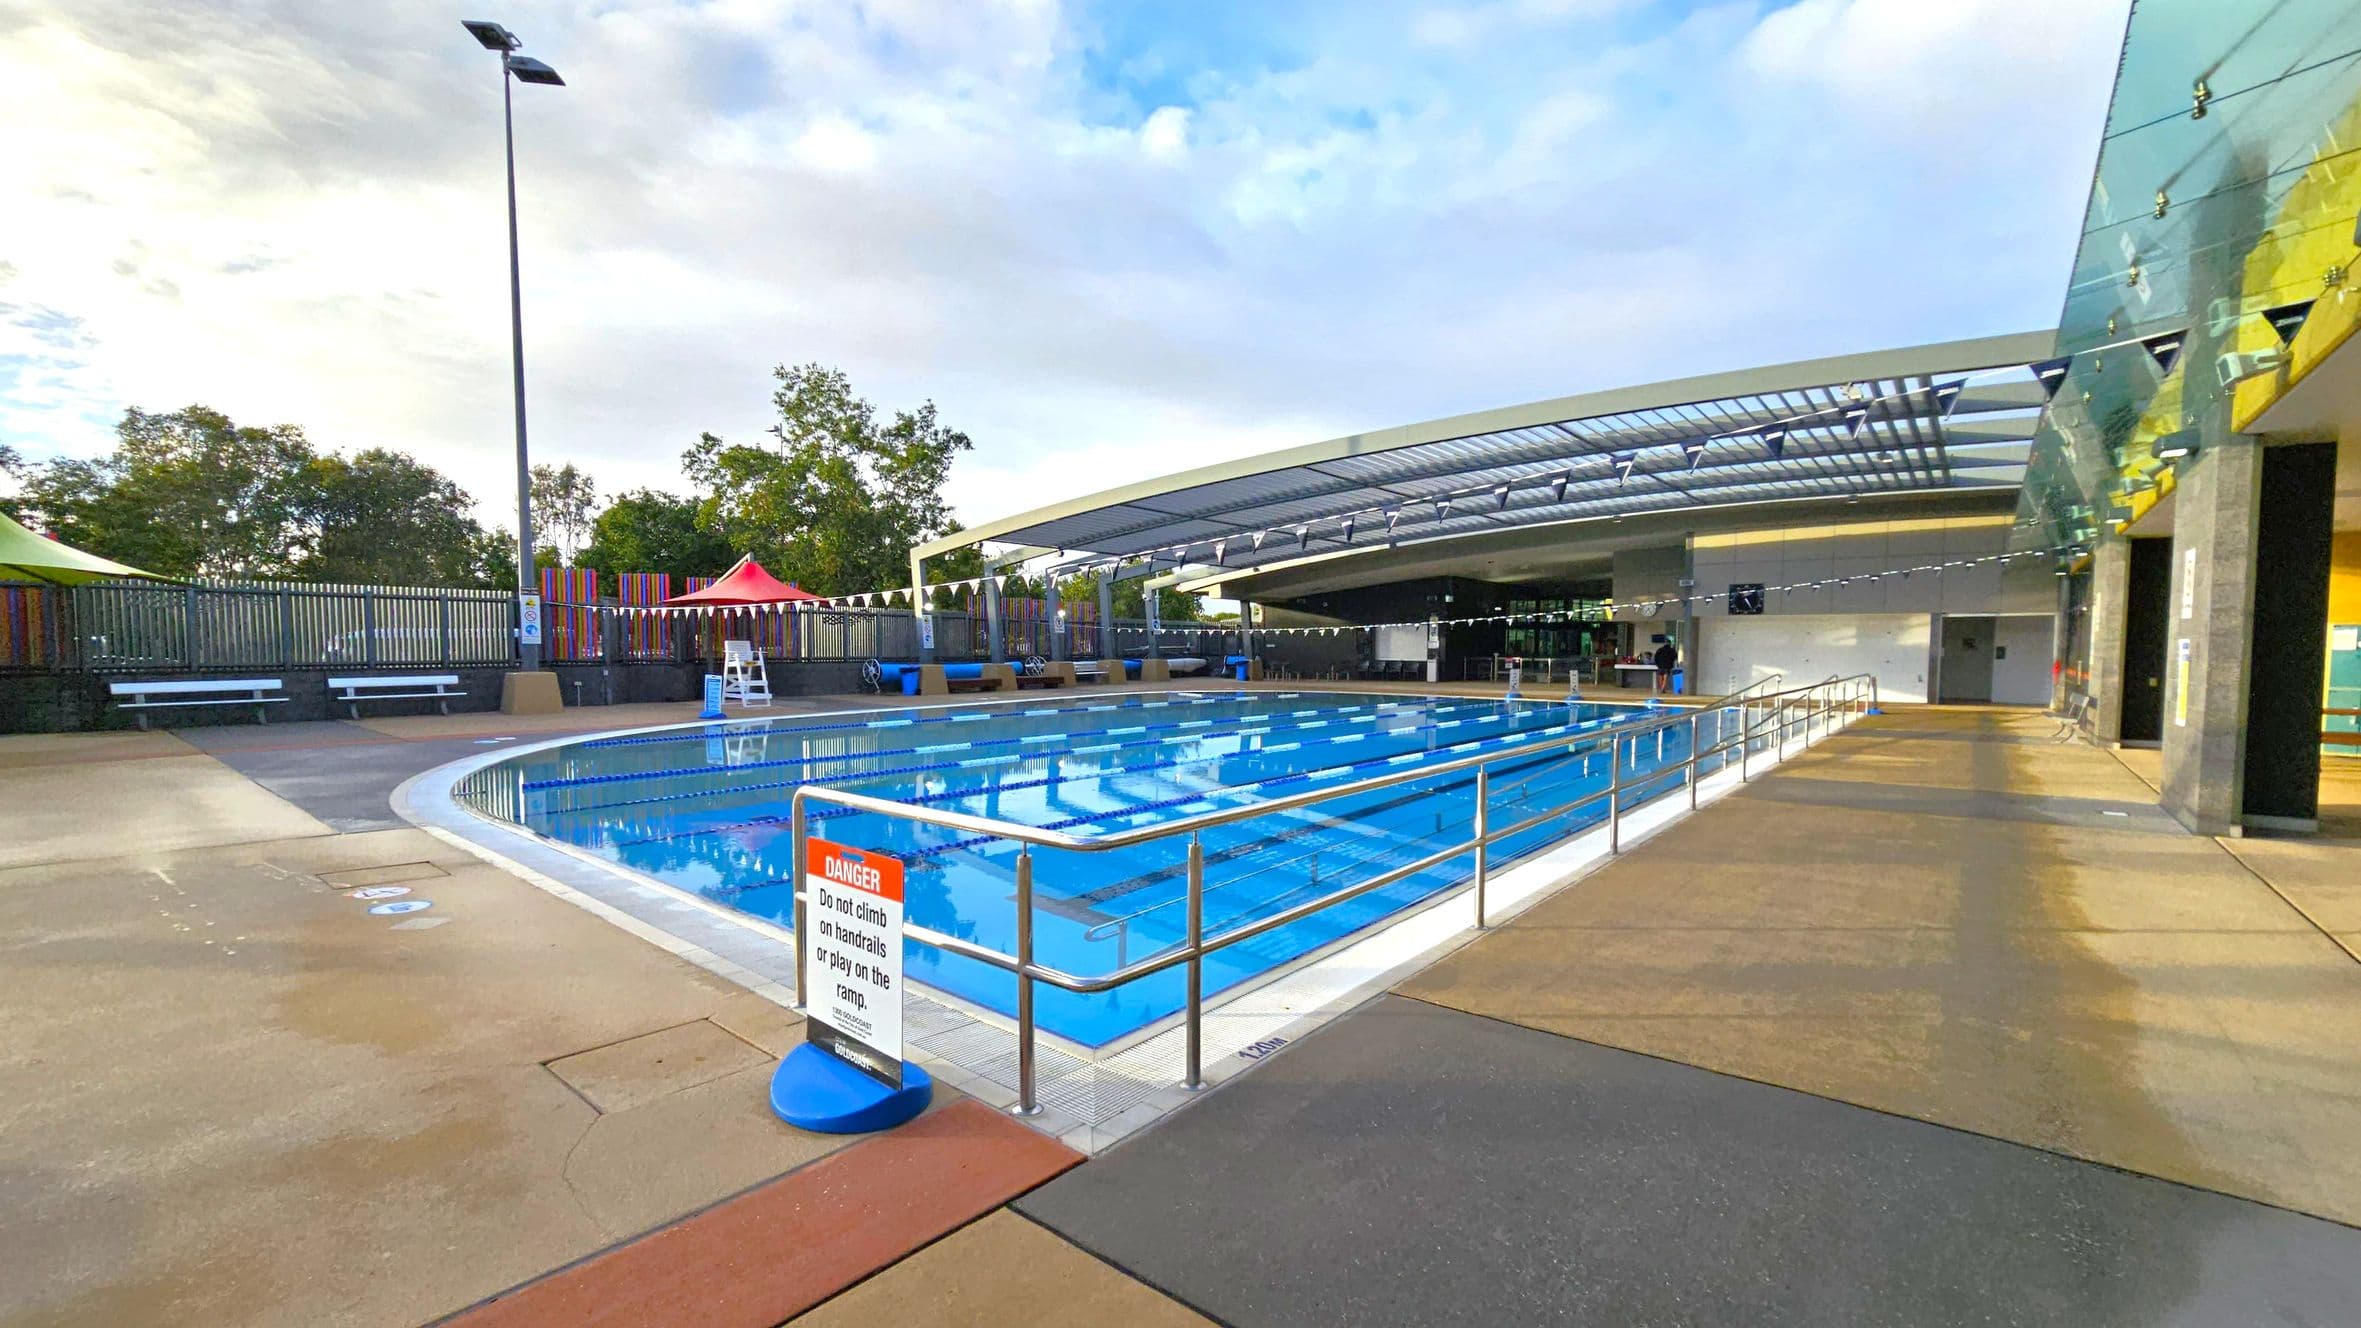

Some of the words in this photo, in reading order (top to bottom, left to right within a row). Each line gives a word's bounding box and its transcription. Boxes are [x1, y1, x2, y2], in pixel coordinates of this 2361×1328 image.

[825, 856, 881, 893] DANGER
[820, 888, 833, 909] Do
[836, 897, 853, 917] not
[856, 901, 887, 928] climb
[820, 920, 833, 937] on
[836, 921, 887, 958] handrails
[817, 946, 828, 963] or
[830, 950, 852, 977] play
[855, 962, 868, 981] on
[872, 965, 890, 990] the
[836, 983, 867, 1011] ramp.
